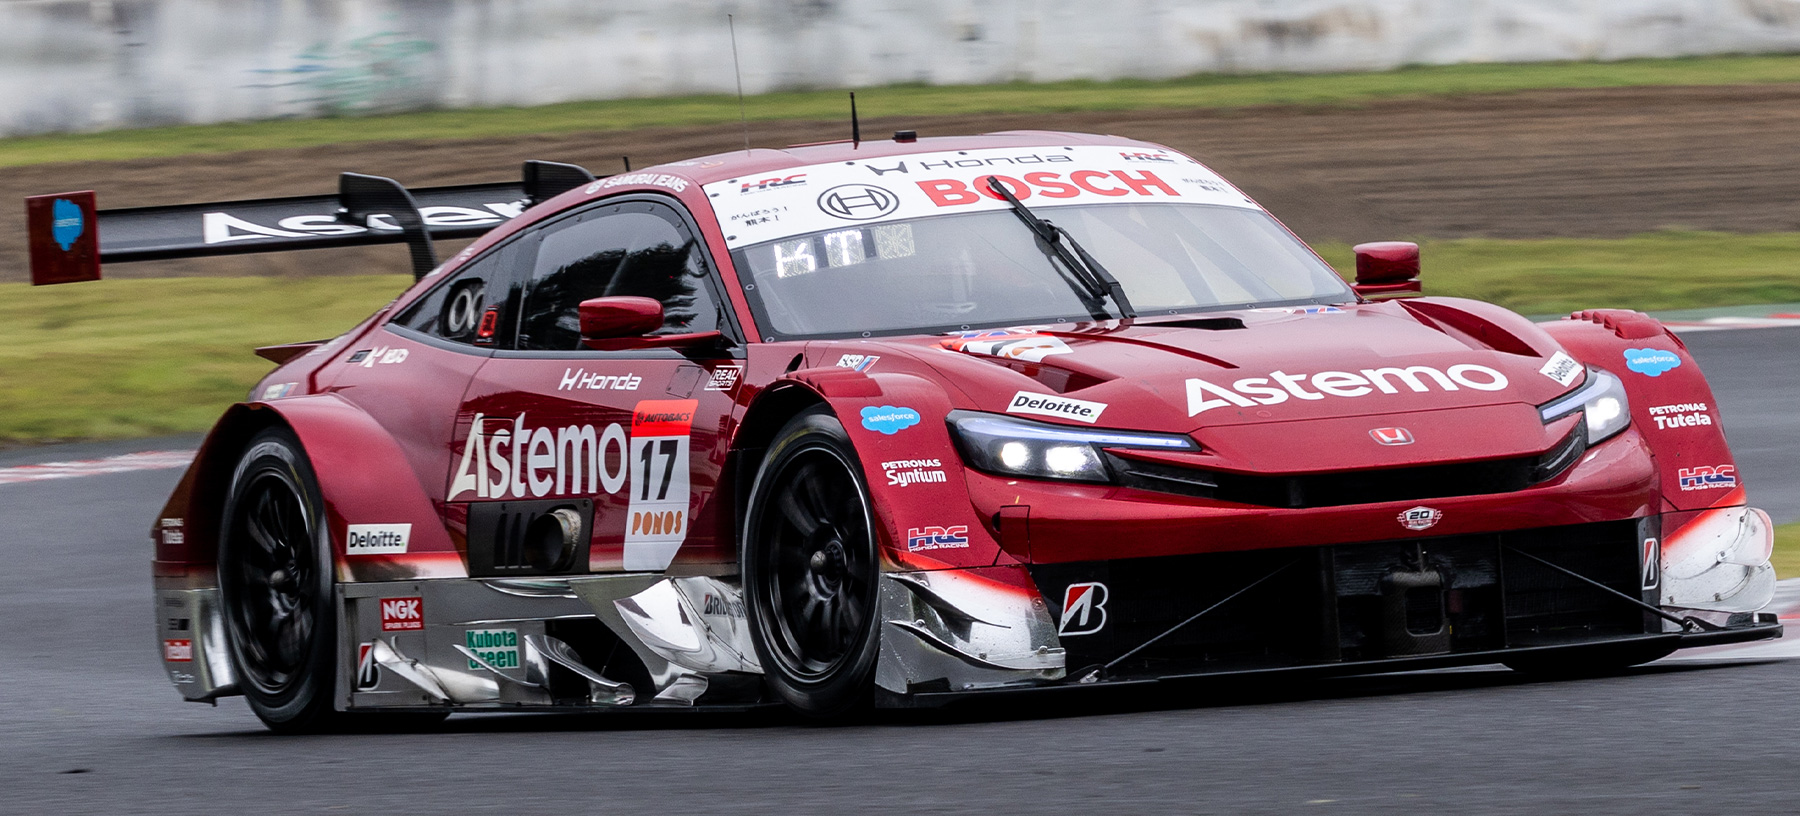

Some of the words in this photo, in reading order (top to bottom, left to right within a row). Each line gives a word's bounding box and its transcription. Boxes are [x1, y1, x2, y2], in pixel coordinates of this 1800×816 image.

[920, 153, 1074, 170] Honda
[740, 174, 807, 194] HRC
[915, 169, 1182, 207] BOSCH
[1631, 354, 1676, 366] salesforce
[577, 372, 643, 390] Honda
[1185, 363, 1509, 418] Astemo
[1013, 395, 1095, 418] Deloitte.
[1649, 402, 1708, 416] PETRONAS
[643, 412, 691, 423] AUTOBACS
[868, 413, 915, 423] salesforce
[1653, 412, 1712, 430] Tutela
[446, 411, 628, 502] Astemo
[880, 458, 942, 471] PETRONAS
[640, 439, 679, 501] 17
[885, 468, 947, 488] Syntium
[1678, 464, 1736, 487] HRC
[631, 510, 683, 536] PONOS
[908, 525, 969, 548] HRC
[382, 599, 421, 620] NGK
[466, 630, 517, 648] Kubota
